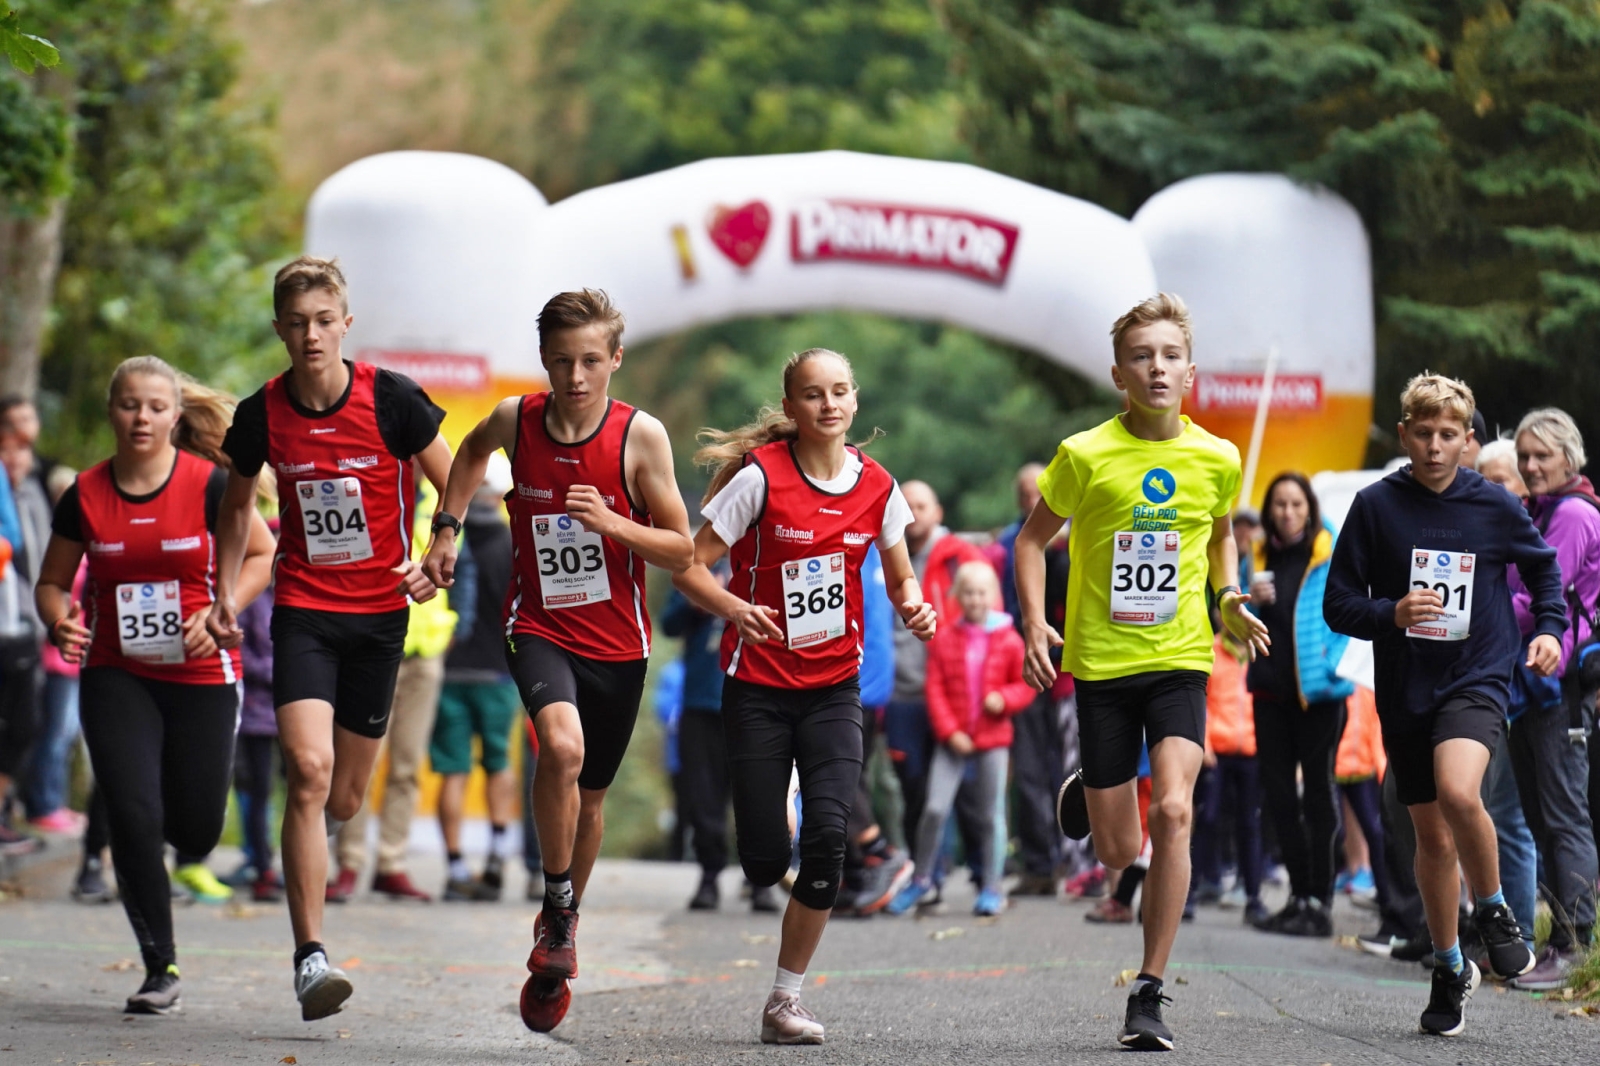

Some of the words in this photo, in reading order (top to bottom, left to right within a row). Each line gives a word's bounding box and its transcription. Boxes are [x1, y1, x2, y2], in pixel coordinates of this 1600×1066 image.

[671, 224, 697, 280] I
[799, 200, 1006, 276] PRIMATOR
[304, 508, 366, 536] 304
[1132, 519, 1172, 531] HOSPIC
[1133, 504, 1155, 519] BĚH
[1157, 508, 1177, 520] PRO
[1422, 528, 1463, 538] DIVISION
[538, 544, 603, 576] 303
[1114, 563, 1176, 592] 302
[787, 583, 844, 619] 368
[122, 611, 180, 640] 358
